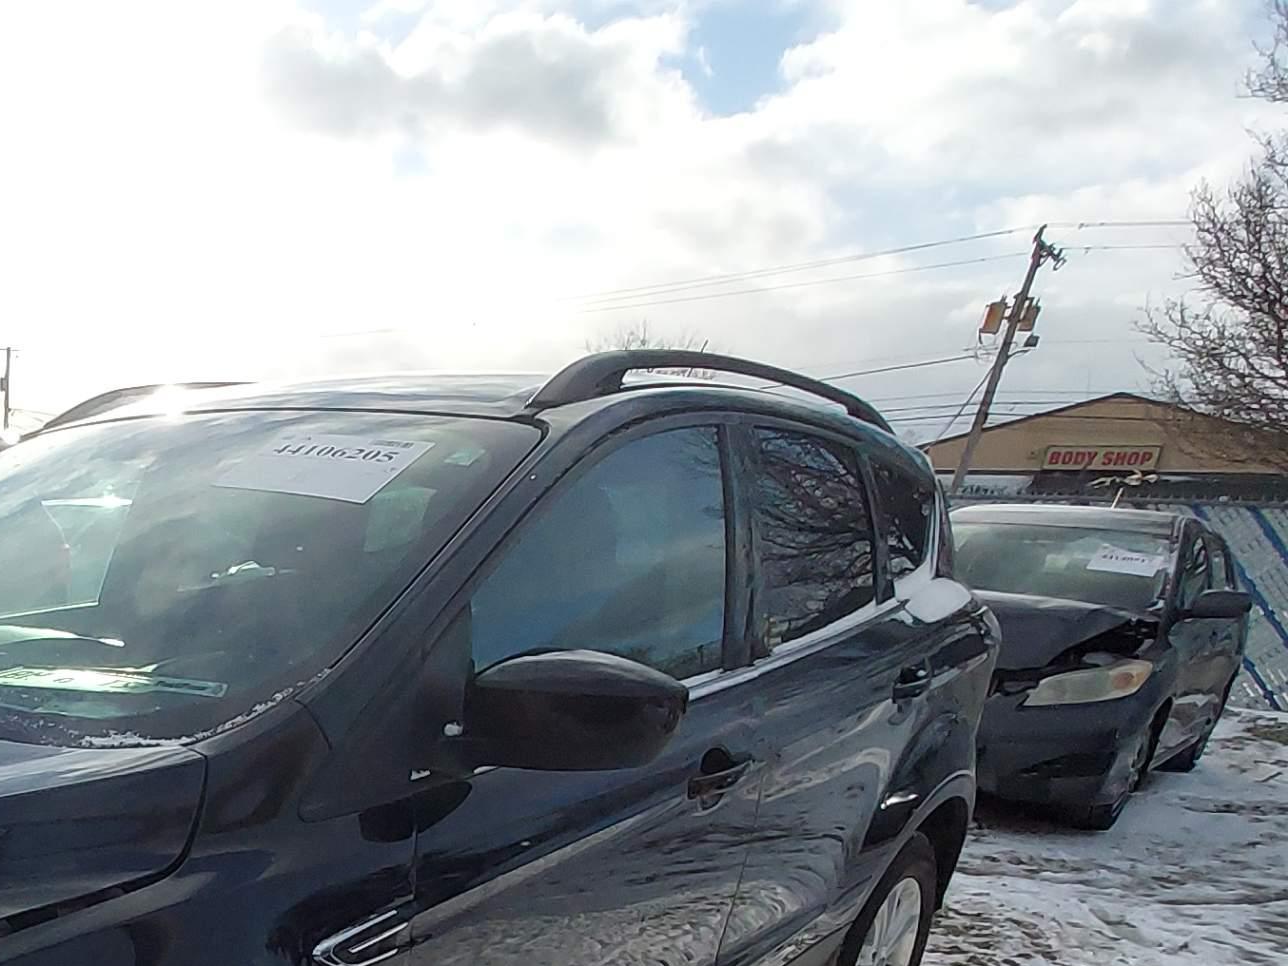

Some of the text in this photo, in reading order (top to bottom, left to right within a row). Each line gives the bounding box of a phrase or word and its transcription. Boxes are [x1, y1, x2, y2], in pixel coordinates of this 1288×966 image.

[273, 444, 400, 463] 44106205
[1047, 451, 1153, 466] BODY SHOP
